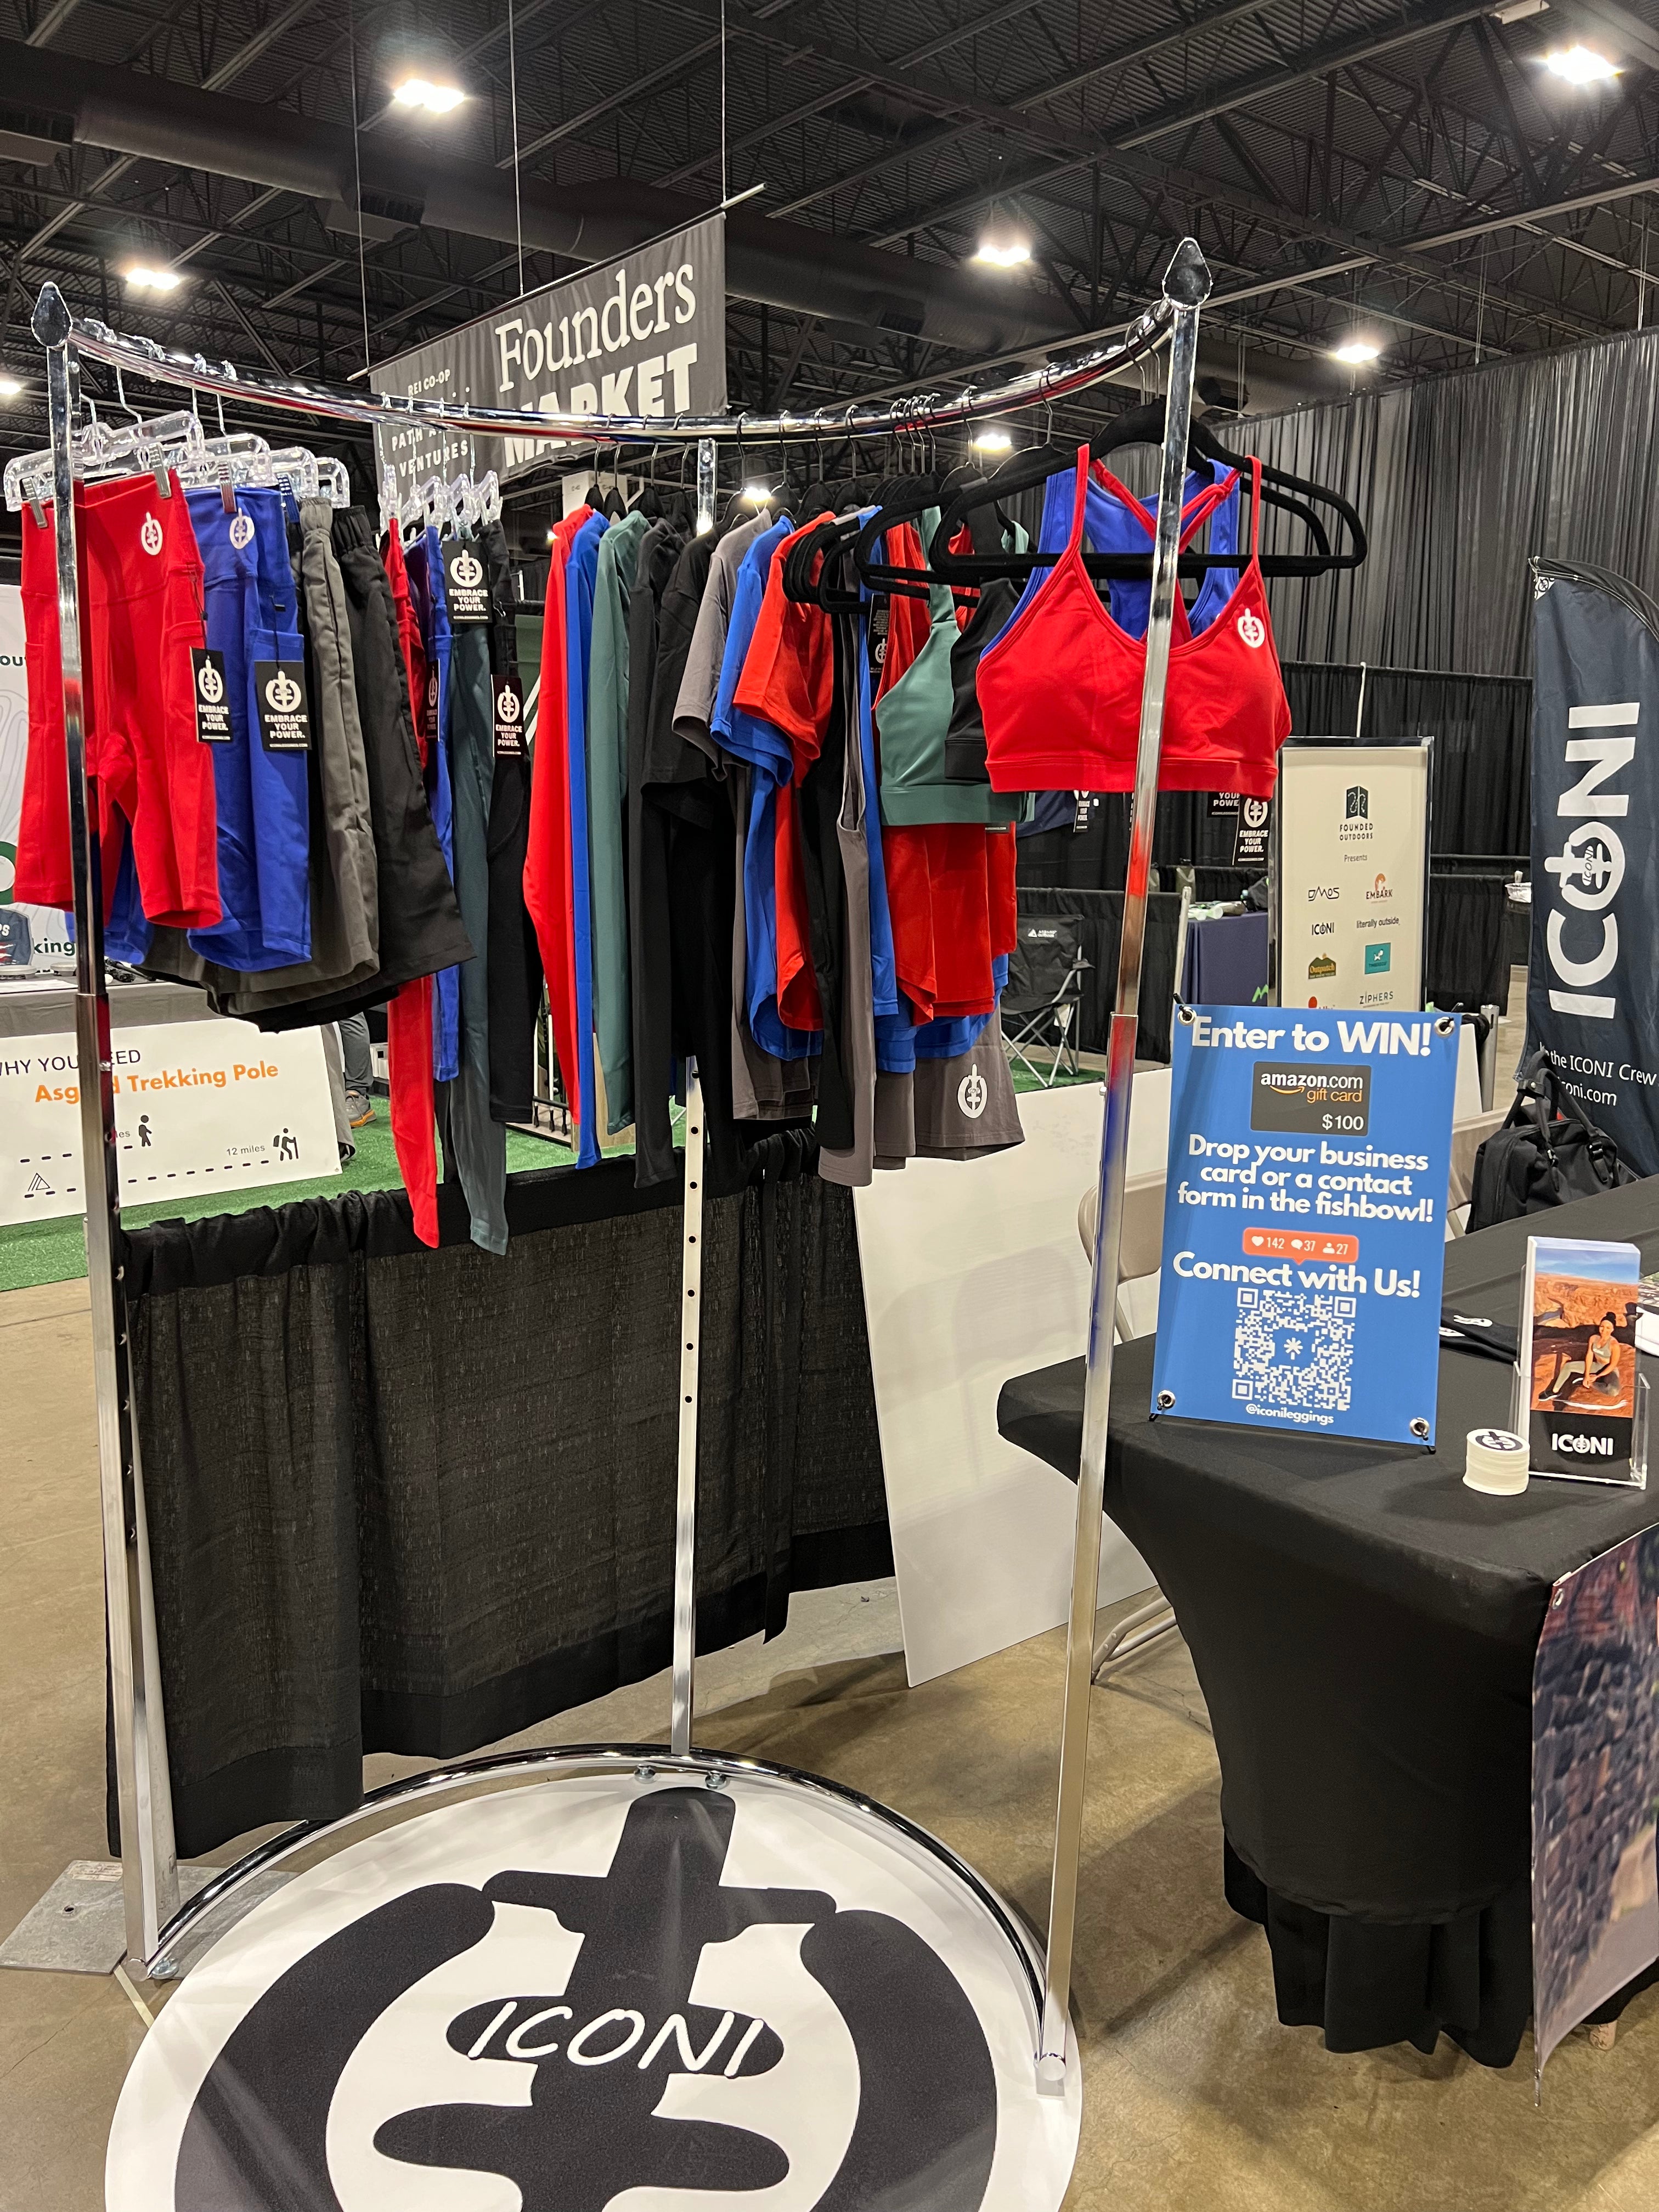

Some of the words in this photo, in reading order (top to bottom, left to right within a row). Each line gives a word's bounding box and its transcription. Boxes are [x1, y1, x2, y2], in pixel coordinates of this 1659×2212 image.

[495, 263, 697, 393] Founders
[408, 381, 422, 396] REI
[424, 369, 450, 390] CO-OP
[392, 428, 423, 452] PATH
[399, 439, 468, 477] VENTURES
[449, 589, 488, 597] EMBRACE
[199, 704, 229, 715] EMBRACE
[205, 714, 224, 722] YOUR
[202, 722, 229, 731] POWER.
[264, 714, 308, 723] EMBRACE
[274, 723, 299, 731] YOUR
[495, 724, 522, 733] EMBRACE
[1239, 830, 1268, 838] EMBRACE
[1339, 823, 1373, 832] FOUNDED
[1339, 832, 1373, 841] OUTDOORS
[1240, 845, 1264, 853] POWER.
[1344, 854, 1368, 862] Presents
[1544, 702, 1640, 1019] ICONI
[1582, 849, 1594, 882] ICONI
[1366, 889, 1393, 900] EMBARK
[1311, 922, 1334, 935] ICONI
[1356, 918, 1378, 929] literally
[1359, 991, 1393, 1005] ZIPHERS
[1191, 1016, 1285, 1050] Enter
[1293, 1024, 1330, 1052] to
[1337, 1021, 1431, 1057] WIN!
[1550, 1050, 1567, 1069] the
[1570, 1055, 1615, 1078] ICONI
[35, 1075, 121, 1104] Asgd
[127, 1068, 226, 1093] Trekking
[234, 1060, 279, 1081] Pole
[1260, 1071, 1363, 1089] amazon.com
[1307, 1089, 1327, 1103] gift
[1331, 1090, 1362, 1102] card
[1322, 1114, 1364, 1131] $100
[227, 1148, 238, 1156] 12
[241, 1144, 266, 1154] miles
[1189, 1133, 1250, 1164] Drop
[1254, 1144, 1316, 1166] your
[1321, 1141, 1429, 1171] business
[1200, 1163, 1257, 1184] card
[1262, 1171, 1291, 1187] or
[1295, 1173, 1312, 1188] a
[1318, 1173, 1412, 1195] contact
[1178, 1181, 1236, 1207] form
[1242, 1188, 1265, 1209] in
[1269, 1189, 1310, 1214] the
[1316, 1192, 1434, 1222] fishbowl!
[1266, 1237, 1285, 1250] 142
[1304, 1240, 1316, 1251] 37
[1336, 1243, 1348, 1255] 27
[1173, 1251, 1293, 1286] Connect
[1297, 1265, 1367, 1294] with
[1374, 1268, 1420, 1298] Us!
[1246, 1403, 1334, 1425] @iconileggings
[1551, 1433, 1614, 1455] ICONI
[468, 2001, 764, 2078] ICONI
